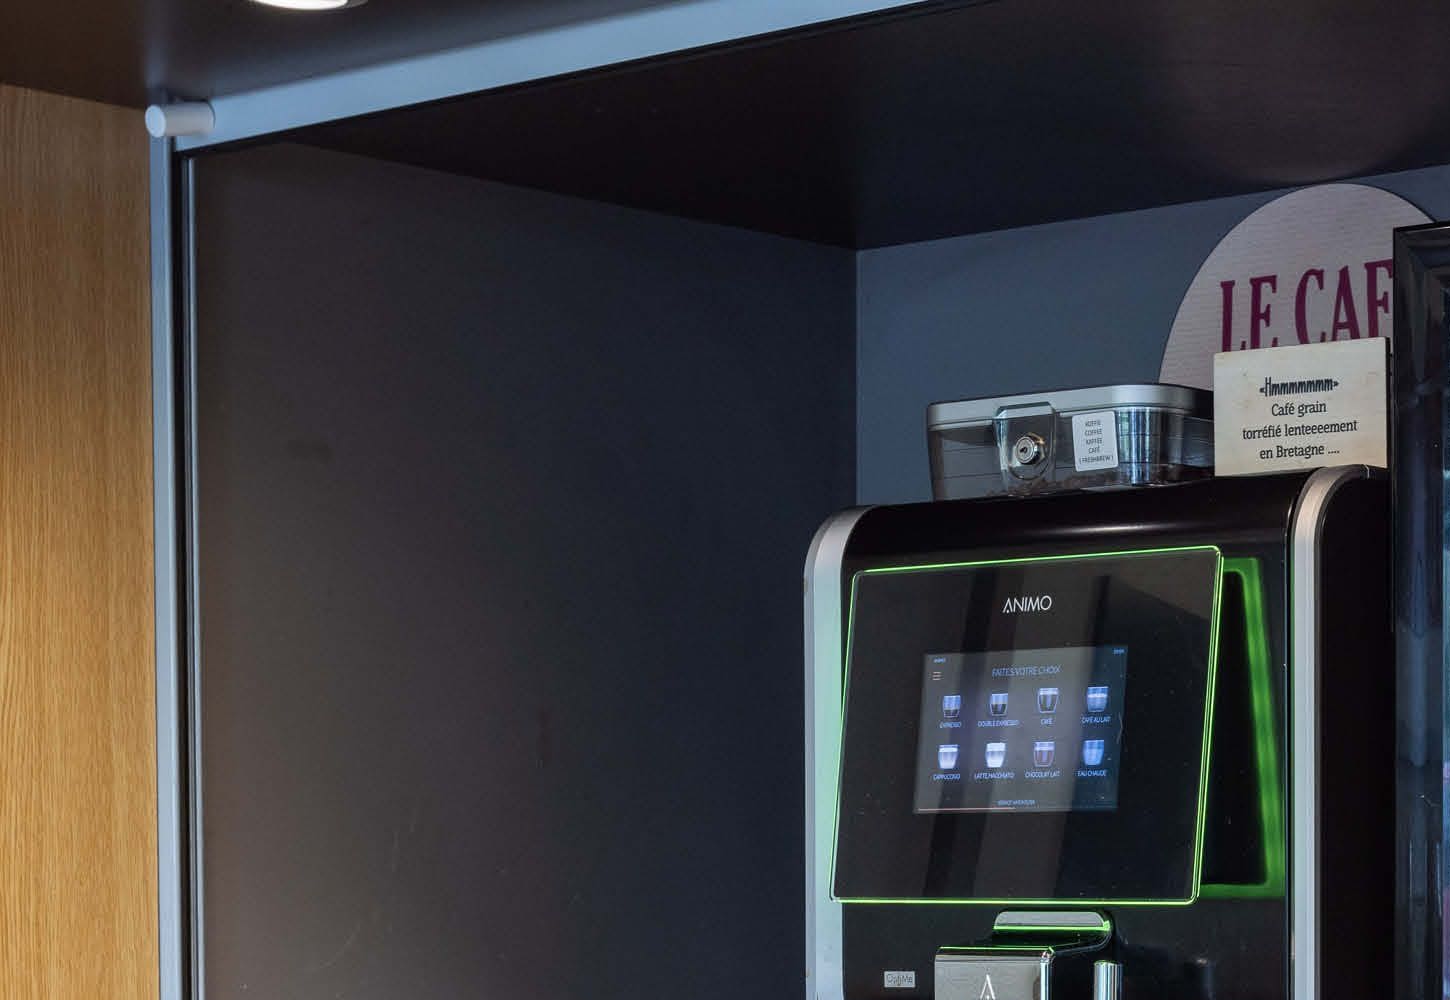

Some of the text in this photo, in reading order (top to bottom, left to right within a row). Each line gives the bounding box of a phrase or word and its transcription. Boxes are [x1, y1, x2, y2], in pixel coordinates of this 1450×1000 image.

[1220, 274, 1278, 352] LE
[1271, 401, 1327, 418] Café grain
[1242, 425, 1282, 440] torréfié
[1259, 448, 1273, 460] en
[1275, 444, 1325, 460] Bretagne
[1002, 595, 1053, 614] ANIMO
